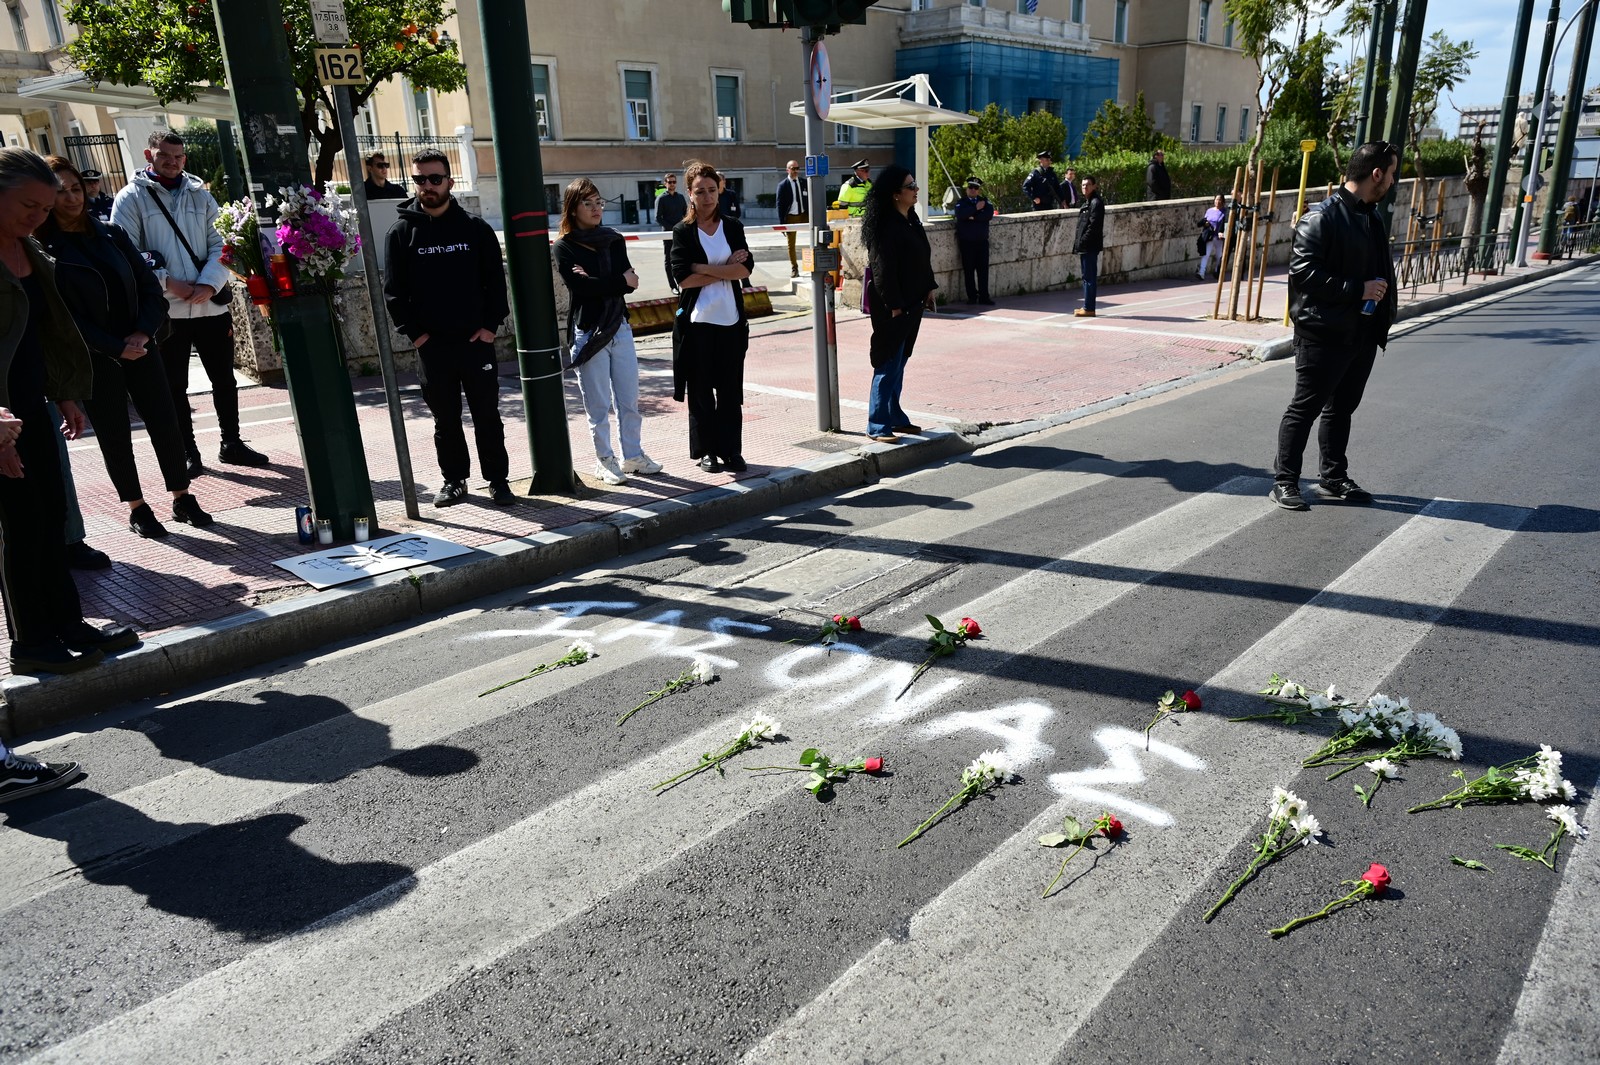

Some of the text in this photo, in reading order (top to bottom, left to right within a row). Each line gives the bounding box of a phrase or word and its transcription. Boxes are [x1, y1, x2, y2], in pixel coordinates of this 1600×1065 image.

[315, 13, 329, 21] 17.5
[328, 23, 339, 31] 3.8
[319, 54, 361, 80] 162
